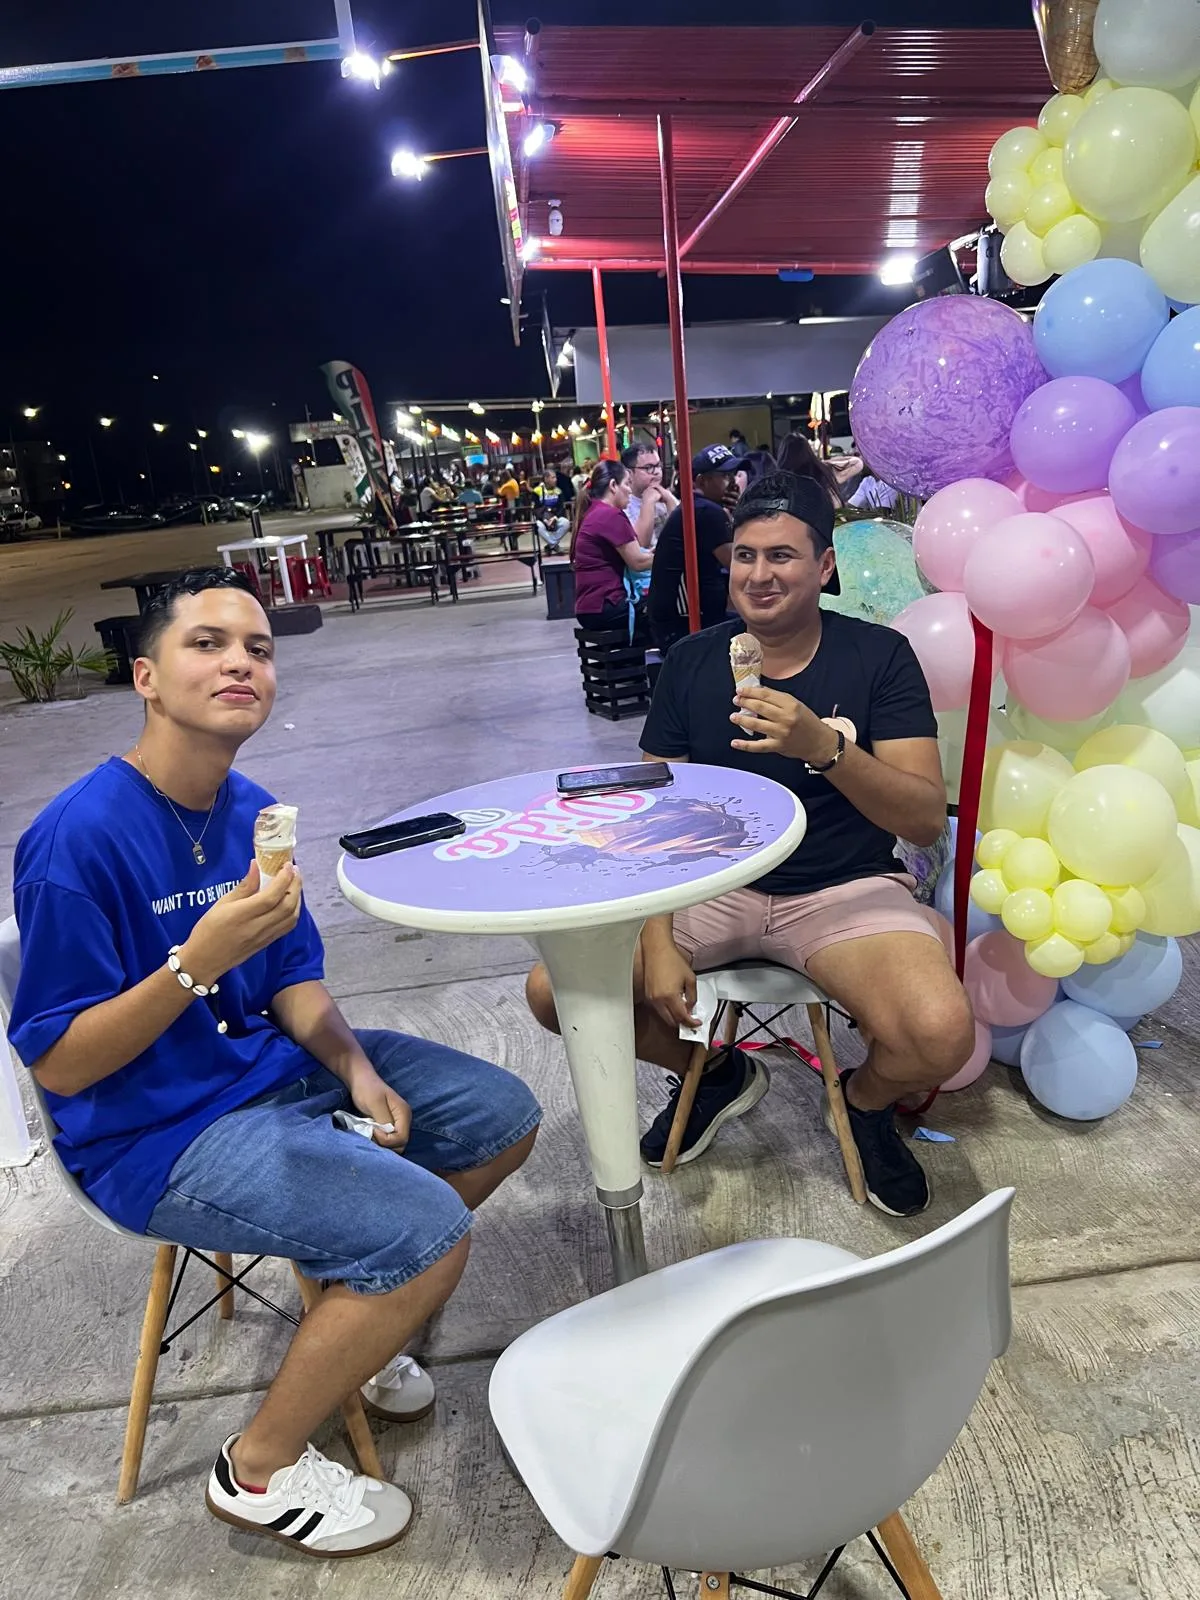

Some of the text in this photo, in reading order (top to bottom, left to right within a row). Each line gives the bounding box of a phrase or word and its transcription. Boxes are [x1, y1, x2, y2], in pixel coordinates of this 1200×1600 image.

[152, 892, 183, 915] WANT
[186, 889, 206, 907] TO
[206, 886, 216, 903] BE
